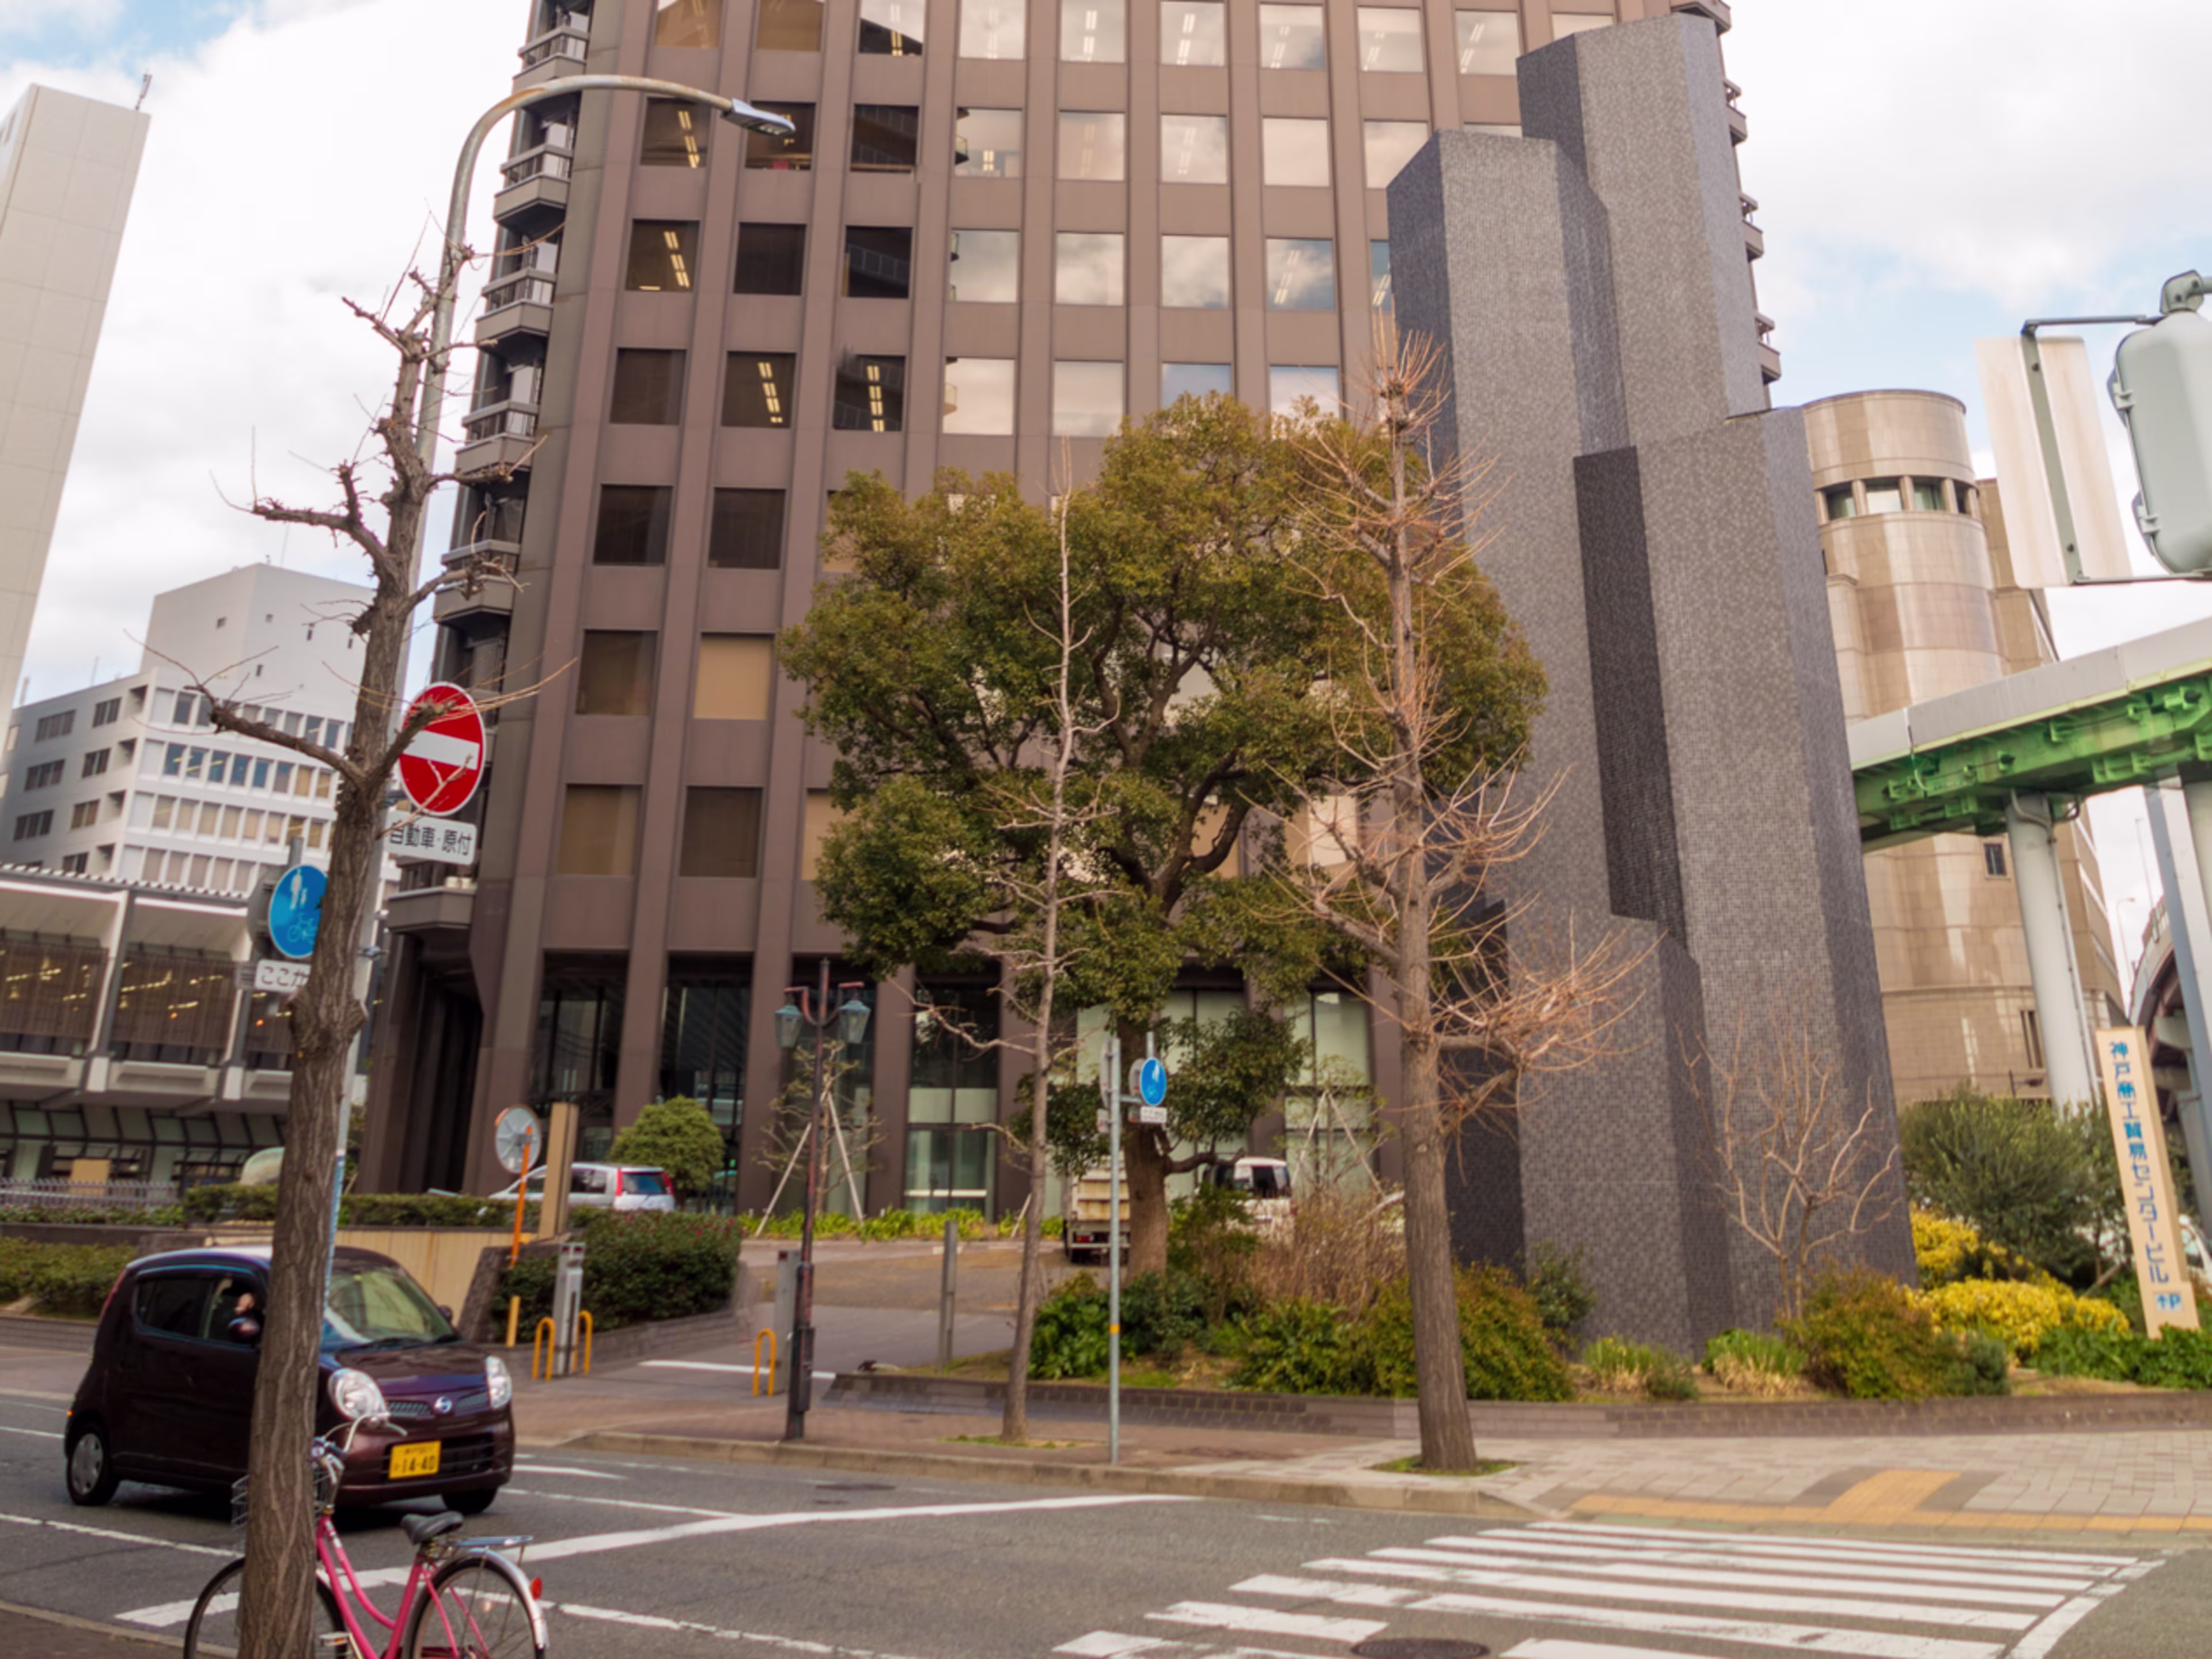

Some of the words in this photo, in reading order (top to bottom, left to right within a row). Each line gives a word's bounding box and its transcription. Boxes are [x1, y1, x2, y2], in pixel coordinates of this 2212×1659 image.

[2109, 1041, 2169, 1284] 神戸商工貿易センタービル
